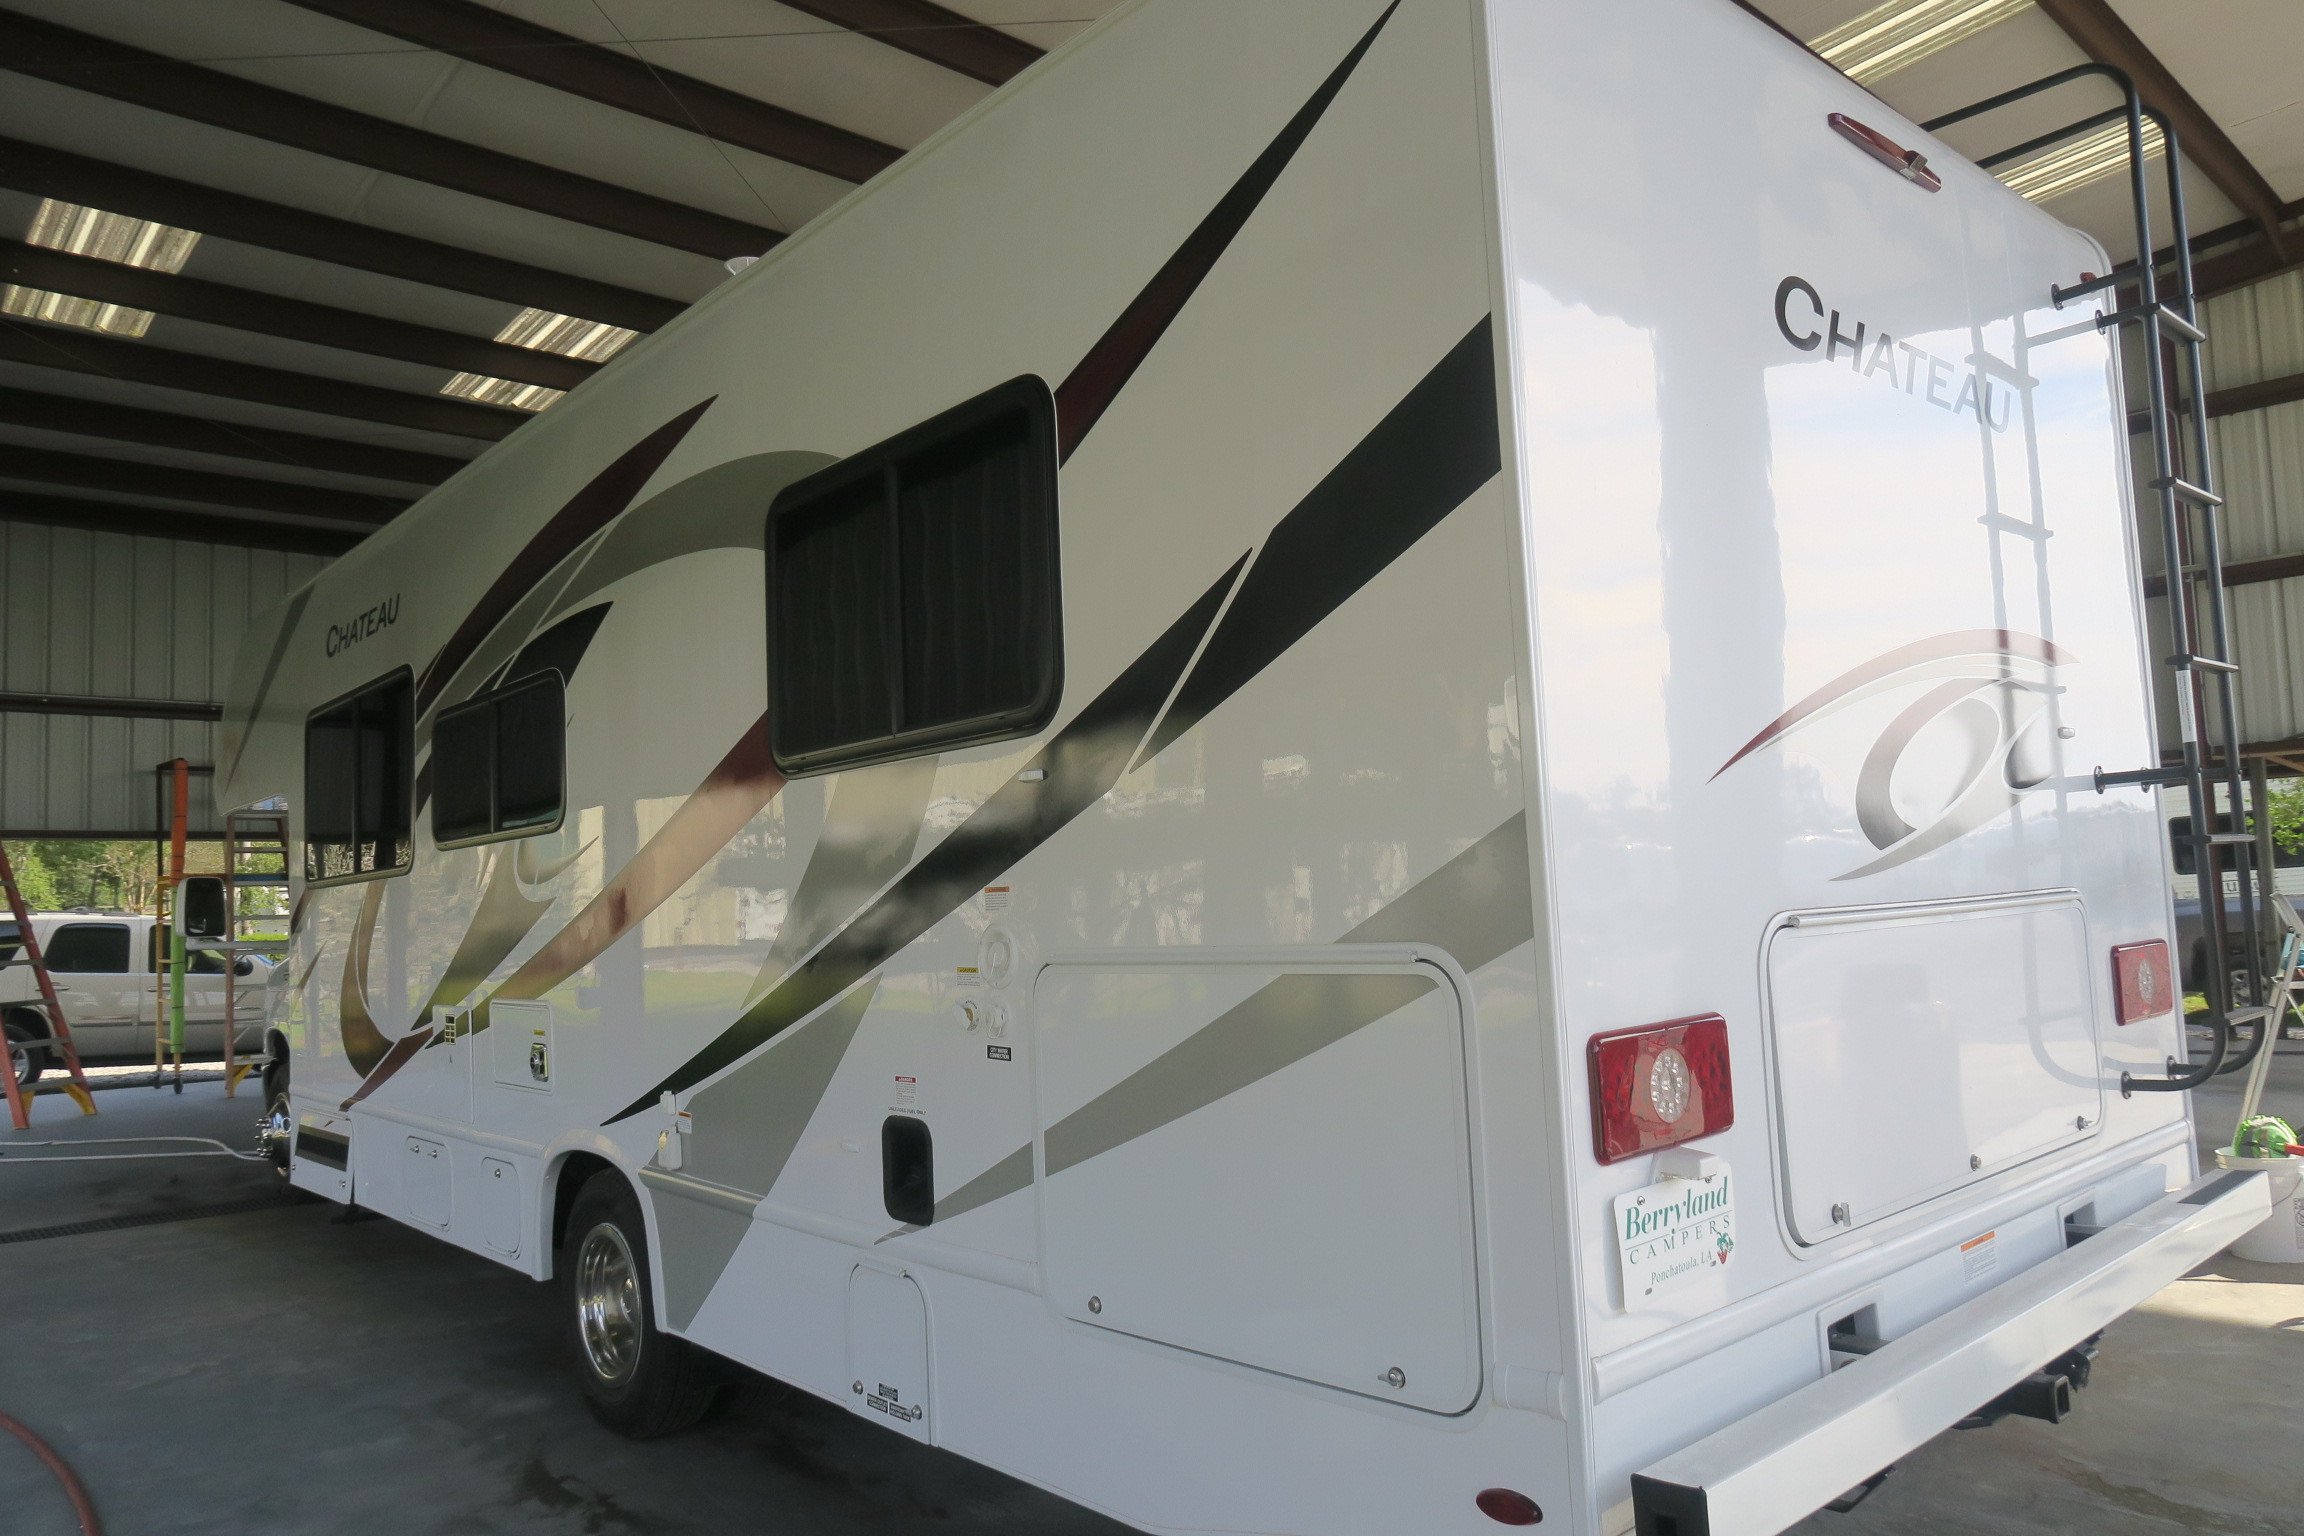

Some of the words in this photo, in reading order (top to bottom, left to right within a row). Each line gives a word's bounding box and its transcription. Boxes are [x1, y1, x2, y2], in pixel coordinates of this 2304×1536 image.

[1774, 275, 2011, 434] CHATEAU
[326, 593, 400, 658] CHATEAU
[1624, 1175, 1728, 1241] Berryland
[1629, 1214, 1730, 1265] CAMPERS
[1650, 1257, 1699, 1285] Ponchatoula,
[1701, 1250, 1712, 1264] LA
